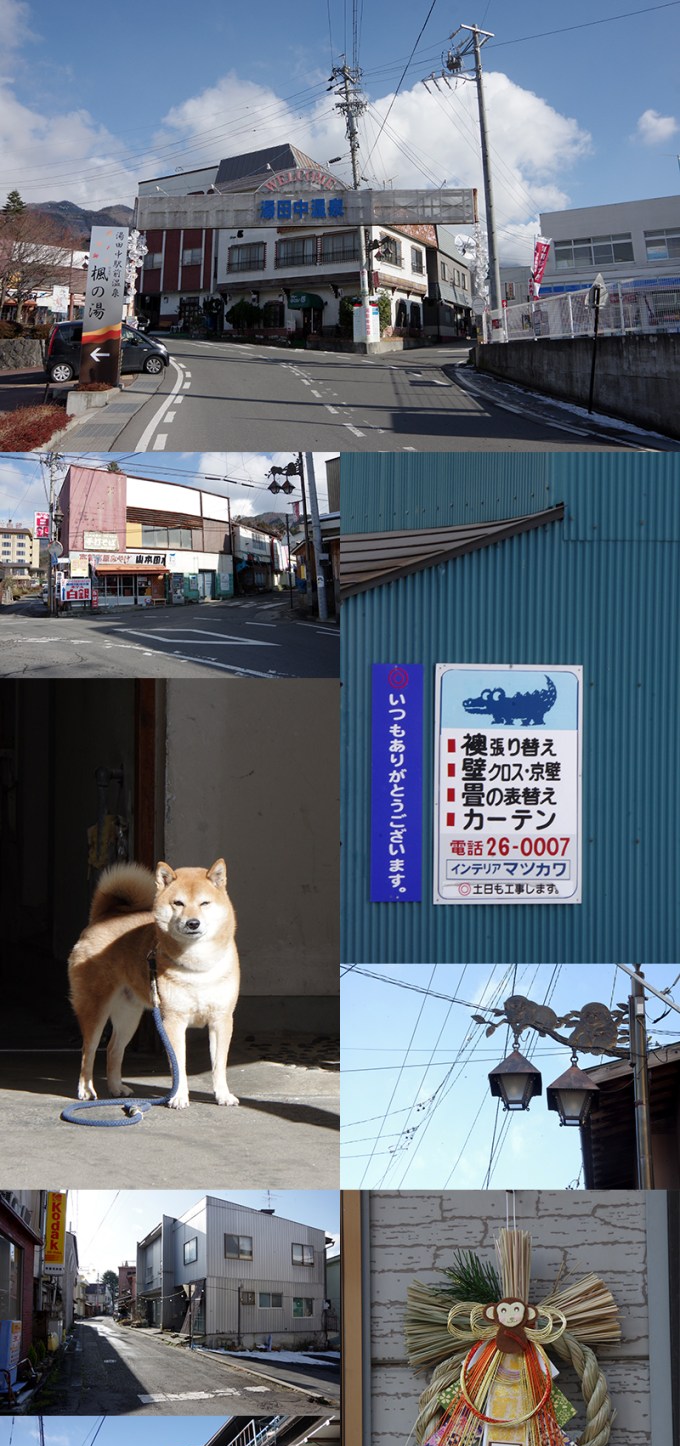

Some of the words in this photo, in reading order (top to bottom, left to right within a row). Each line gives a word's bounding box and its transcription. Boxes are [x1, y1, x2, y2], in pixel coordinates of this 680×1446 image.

[264, 170, 337, 192] WELCOME
[111, 231, 124, 298] 湯田中駅前温泉
[88, 265, 109, 320] 楓の湯
[461, 733, 557, 757] 襖張り替え
[388, 693, 407, 893] いつもありがとうございます。
[461, 782, 557, 807] 畳の表替え
[463, 808, 556, 831] カーテン
[50, 1202, 61, 1251] Kodak
